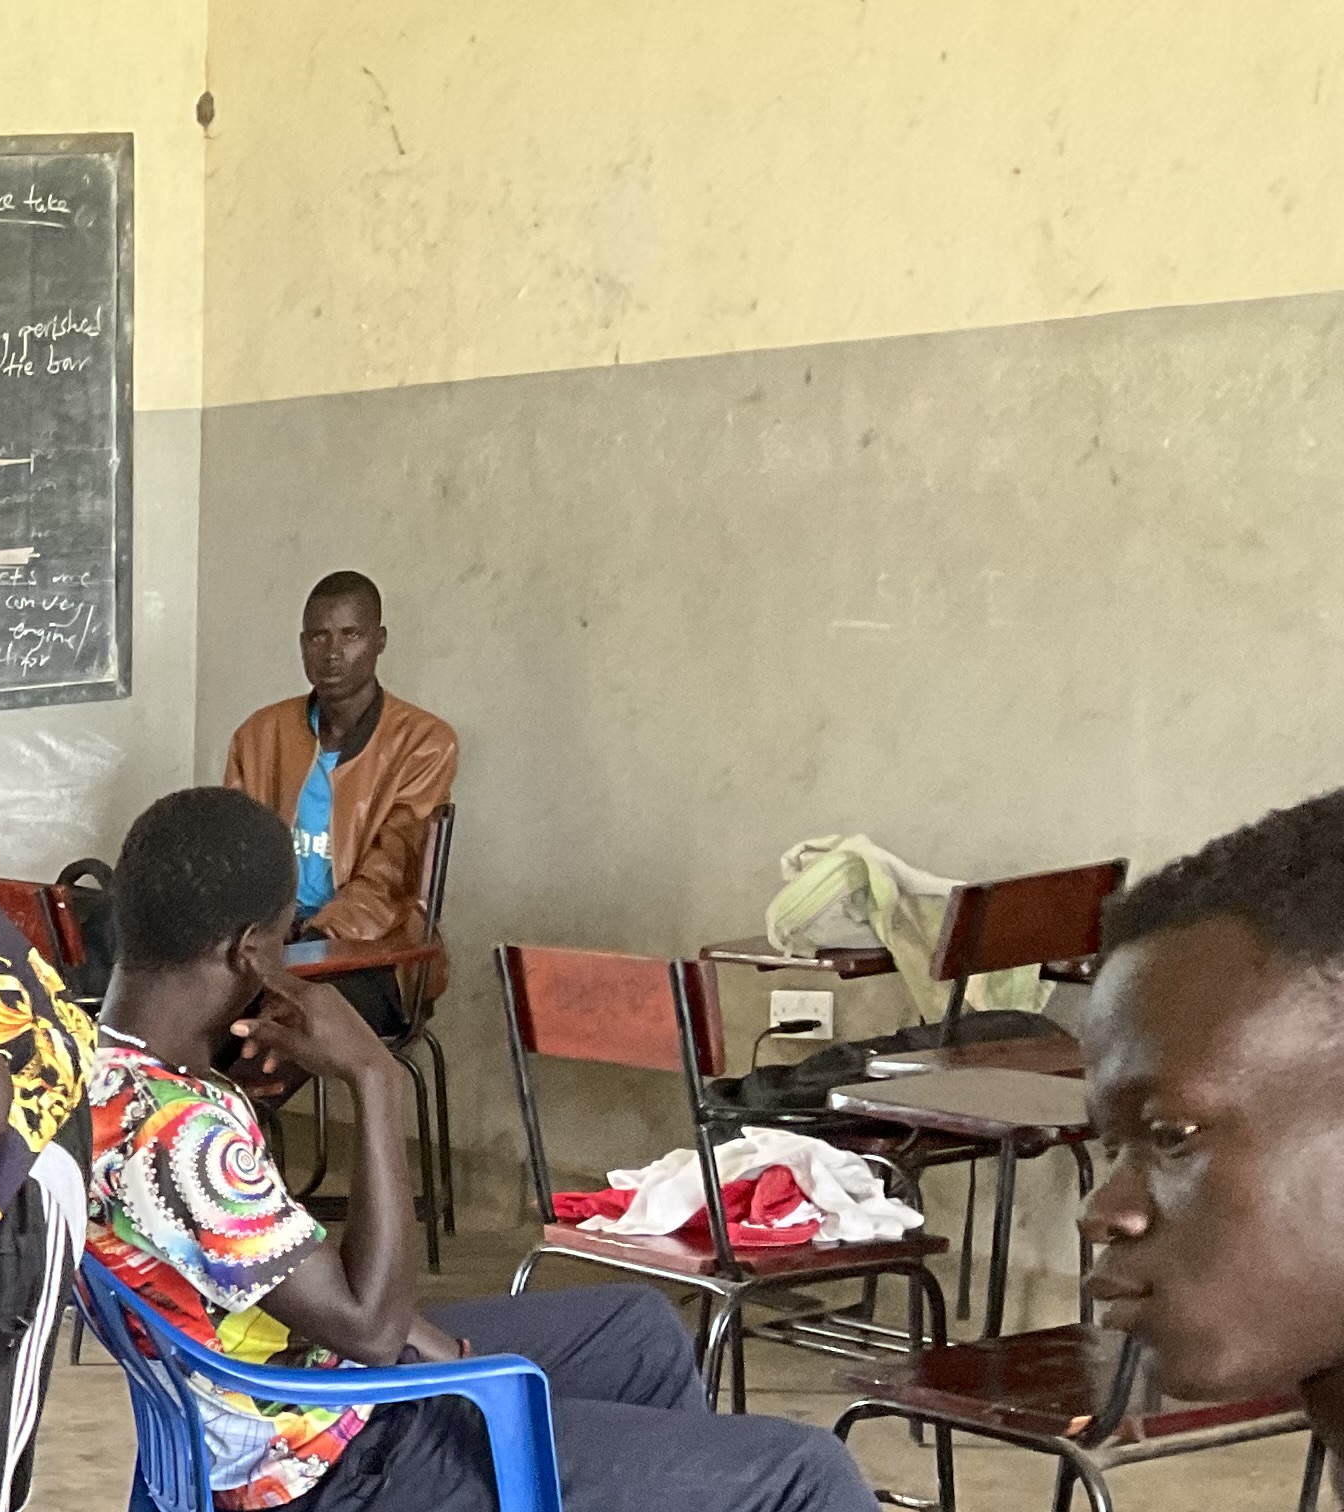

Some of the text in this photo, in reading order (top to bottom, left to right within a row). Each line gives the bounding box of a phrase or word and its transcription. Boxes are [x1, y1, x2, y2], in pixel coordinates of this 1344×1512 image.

[23, 183, 72, 215] take
[17, 305, 102, 363] perished
[2, 352, 35, 378] tie
[46, 344, 92, 375] bar
[52, 571, 91, 588] are
[5, 595, 85, 628] convey
[20, 648, 50, 678] for
